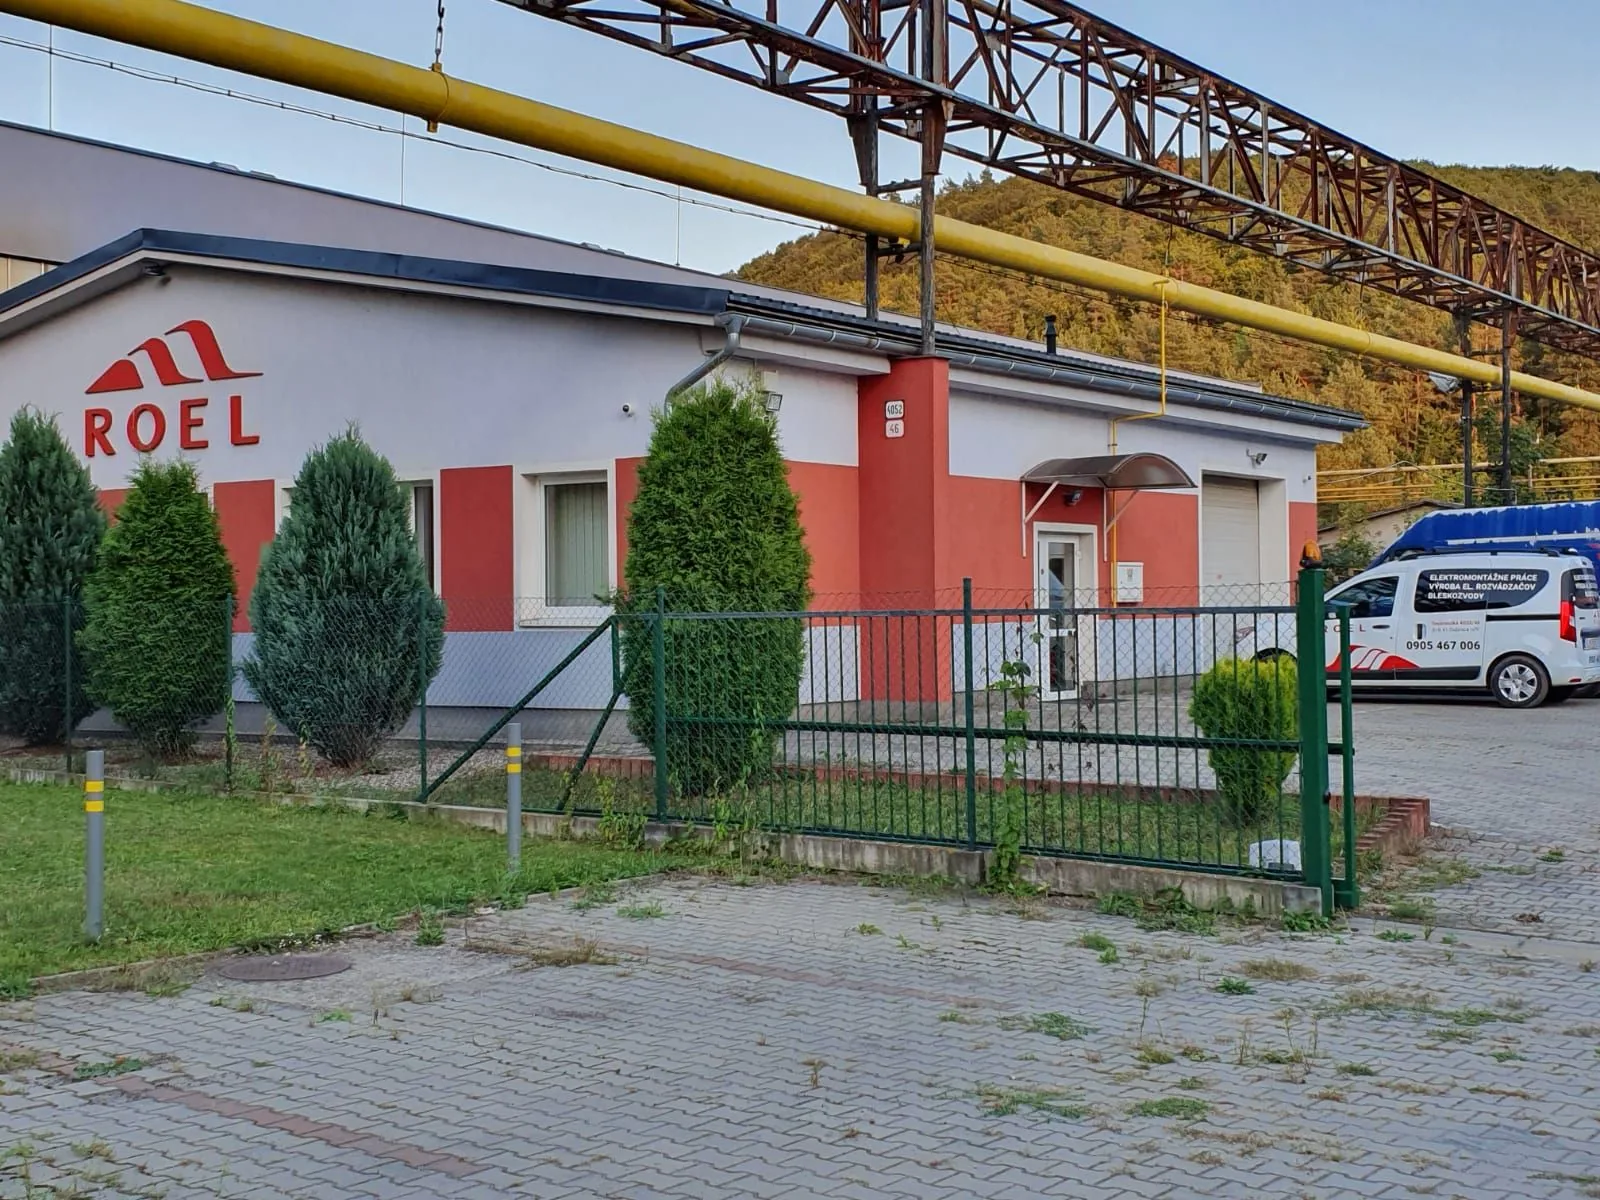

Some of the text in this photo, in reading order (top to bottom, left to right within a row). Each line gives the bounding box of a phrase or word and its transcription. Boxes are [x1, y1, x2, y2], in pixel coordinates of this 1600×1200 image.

[887, 404, 903, 415] 4052
[84, 395, 260, 457] ROEL
[889, 423, 899, 433] 46
[1429, 572, 1538, 581] ELEKTROMONTÁŽNE PRÁCE
[1428, 582, 1461, 590] VÝROBA
[1475, 582, 1536, 591] ROZVÁDZAČOV
[1427, 592, 1485, 600] BLESKOZVODY
[1406, 641, 1481, 650] 0905 467 006
